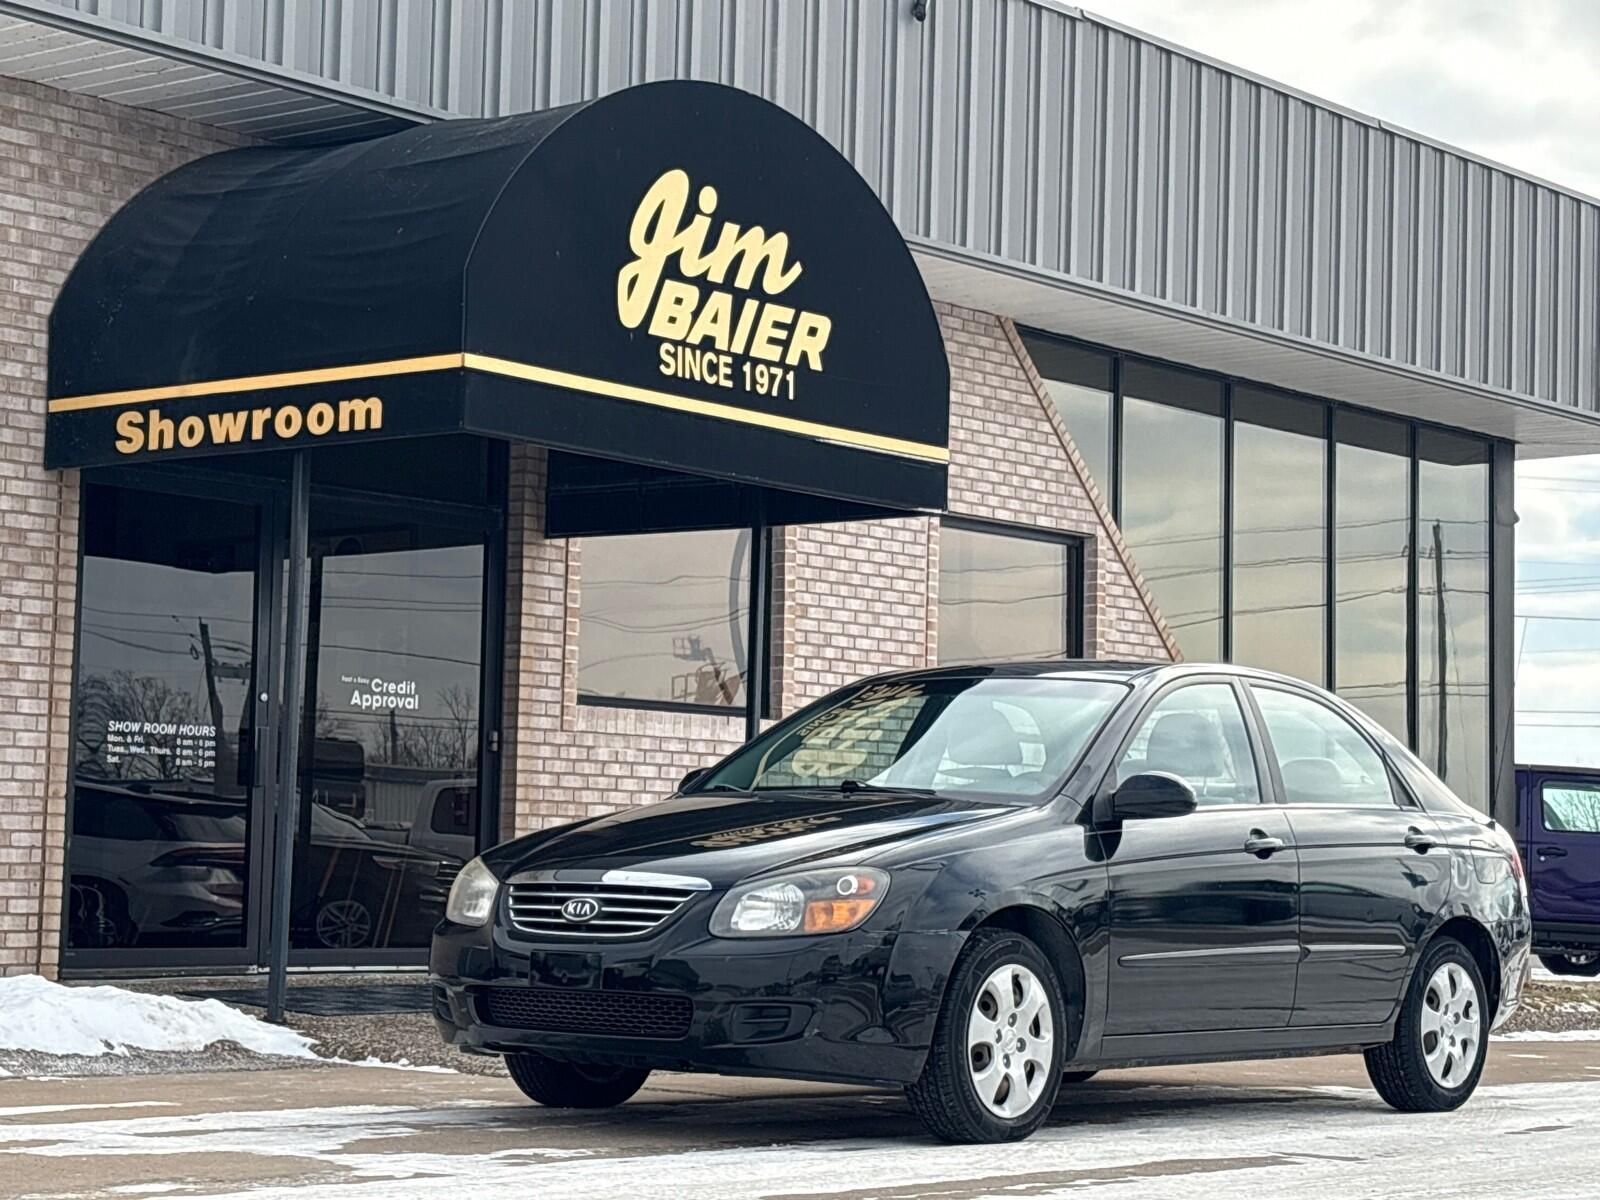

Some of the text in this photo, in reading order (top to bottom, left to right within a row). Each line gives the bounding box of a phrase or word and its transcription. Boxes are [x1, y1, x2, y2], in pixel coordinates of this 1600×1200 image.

[617, 169, 803, 329] Jim
[648, 279, 832, 372] BAIER
[659, 342, 795, 400] SINCE 1971
[115, 396, 383, 454] Showroom
[350, 690, 419, 710] Approval
[371, 678, 416, 695] Credit
[107, 720, 217, 737] SHOW ROOM HOURS
